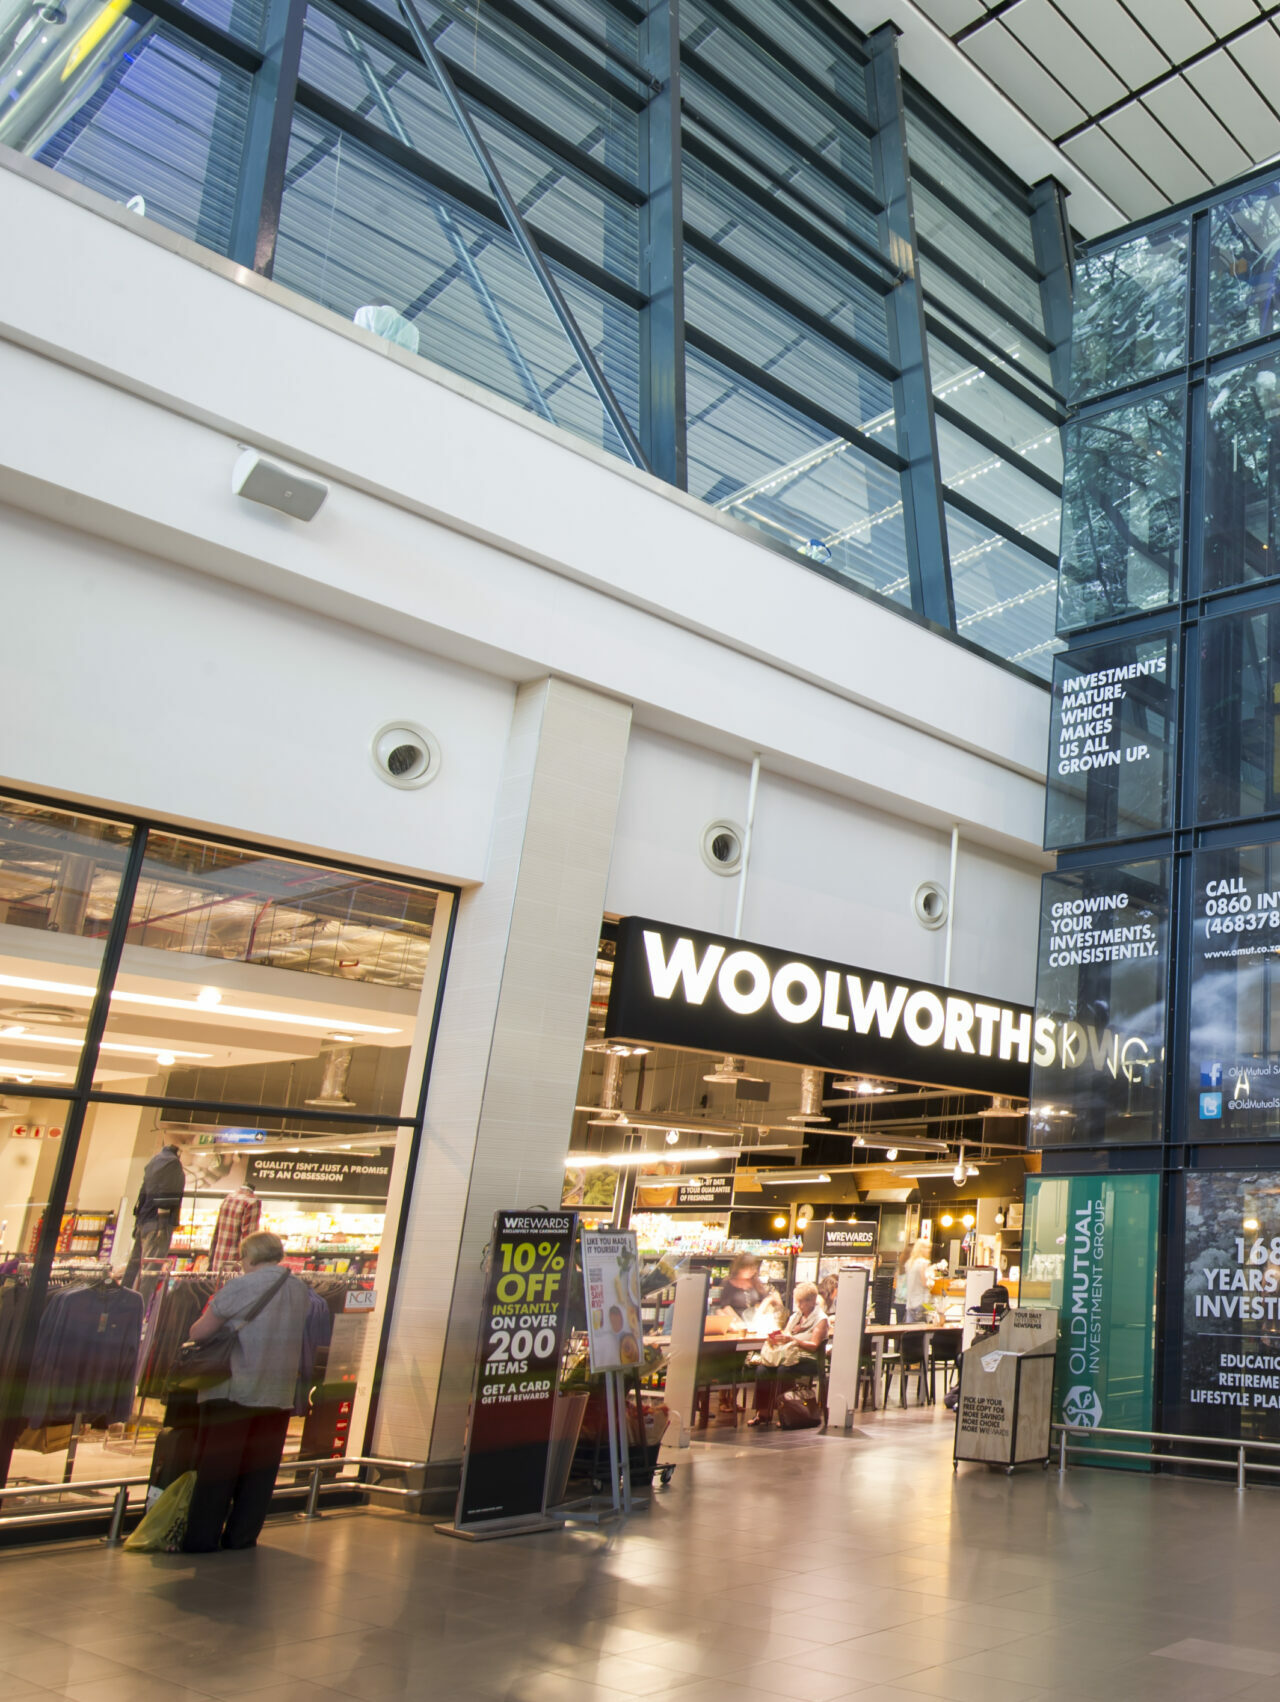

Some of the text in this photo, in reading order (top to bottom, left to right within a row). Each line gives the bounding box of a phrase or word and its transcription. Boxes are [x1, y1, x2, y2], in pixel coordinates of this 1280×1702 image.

[1063, 657, 1166, 692] INVESTMENTS
[1063, 685, 1126, 708] MATURE,
[1061, 702, 1113, 725] WHICH
[1060, 719, 1112, 742] MAKES
[1059, 737, 1109, 758] US ALL
[1058, 745, 1149, 774] GROWN UP.
[1206, 877, 1246, 897] CALL
[1051, 894, 1128, 917] GROWING
[1205, 896, 1251, 918] 0860
[1051, 915, 1092, 933] YOUR
[1050, 925, 1155, 950] INVESTMENTS.
[1049, 942, 1159, 967] CONSISTENTLY.
[1204, 945, 1280, 959] www.omut.co.za
[643, 929, 1056, 1067] WOOLWORTHS
[1228, 1066, 1243, 1077] Old
[1246, 1065, 1271, 1075] Mutual
[254, 1160, 389, 1175] QUALITY ISN'T JUST A PROMISE
[259, 1170, 275, 1179] IT'S
[276, 1171, 291, 1179] AN
[293, 1171, 344, 1182] OBSESSION
[504, 1217, 569, 1228] WREWARDS
[587, 1237, 627, 1246] LIKE YOU MADE
[827, 1231, 873, 1241] WREWARDS
[500, 1241, 564, 1273] 10%
[587, 1245, 619, 1254] IT YOURSELF
[496, 1273, 561, 1303] OFF
[1069, 1200, 1092, 1375] OLDMUTUAL
[1089, 1199, 1106, 1374] INVESTMENT GROUP
[1203, 1268, 1280, 1292] YEARS
[492, 1302, 559, 1316] INSTANTLY
[491, 1315, 557, 1330] ON OVER
[487, 1328, 555, 1361] 200
[485, 1360, 528, 1376] ITEMS
[482, 1380, 550, 1395] GET A CARD
[481, 1391, 549, 1405] GET THE REWARDS
[987, 1398, 1002, 1406] YOUR
[1190, 1390, 1249, 1407] LIFESTYLE
[963, 1410, 1005, 1421] MORE SAVINGS
[980, 1420, 1000, 1428] CHOICE
